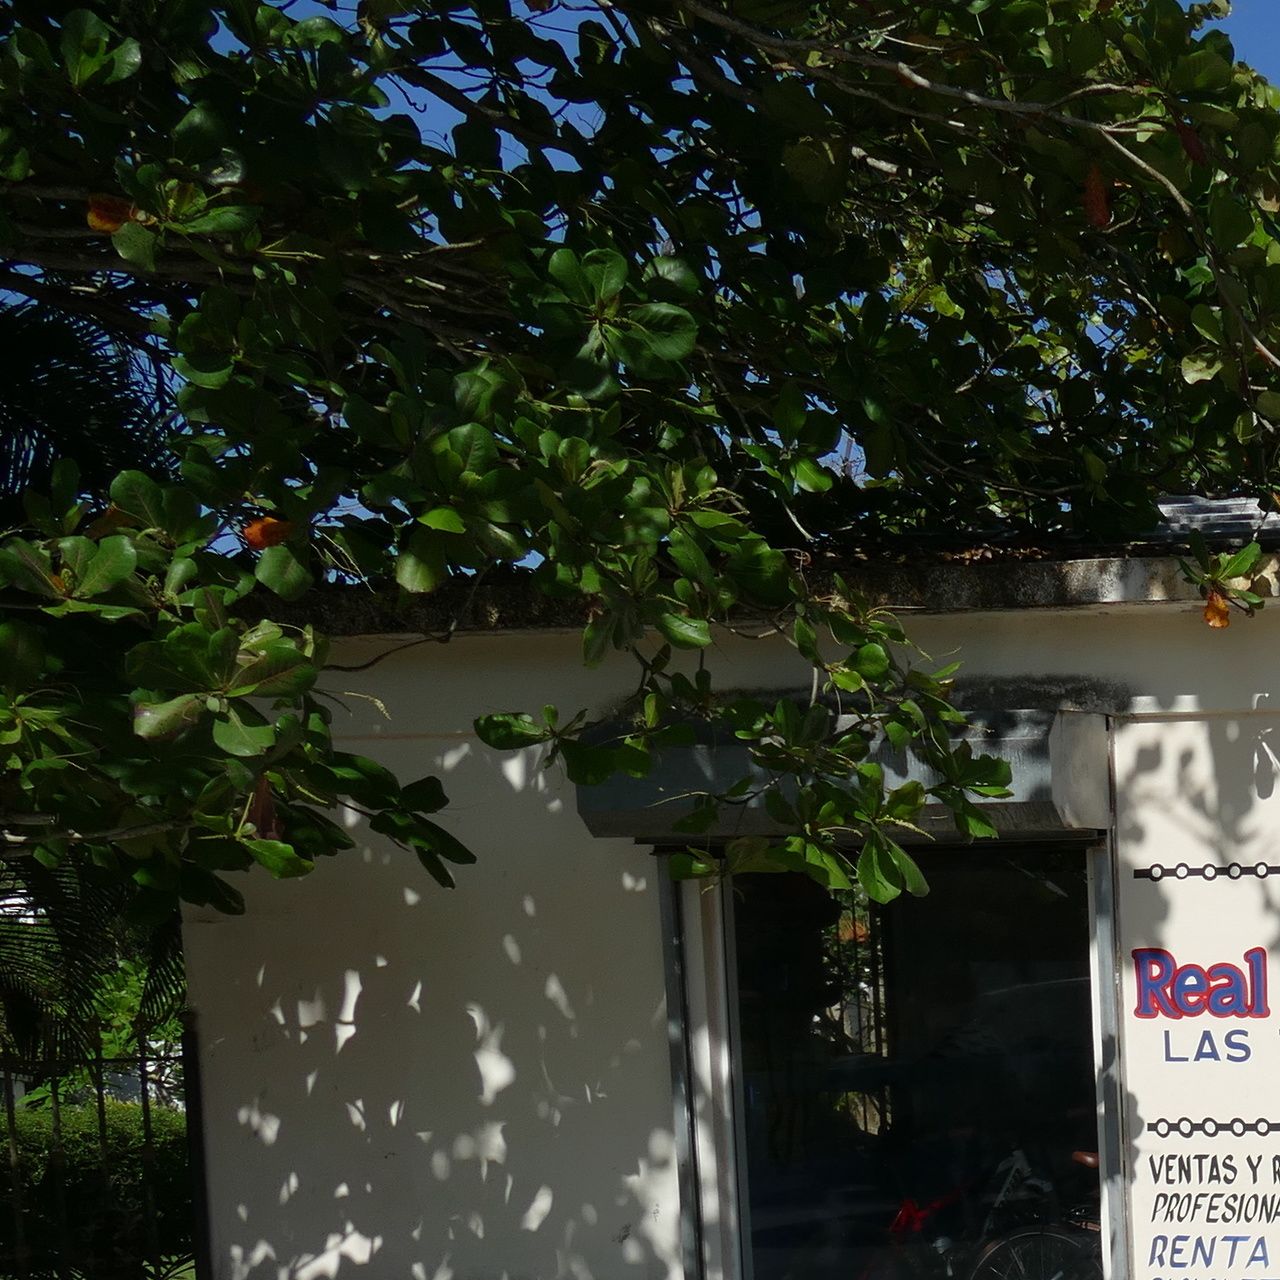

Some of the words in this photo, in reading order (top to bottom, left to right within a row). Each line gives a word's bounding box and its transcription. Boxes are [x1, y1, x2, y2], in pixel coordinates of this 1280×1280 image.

[1131, 946, 1269, 1020] Real
[1163, 1028, 1252, 1063] LAS
[1149, 1154, 1238, 1186] VENTAS
[1247, 1156, 1265, 1187] Y
[1148, 1234, 1270, 1269] RENTA
